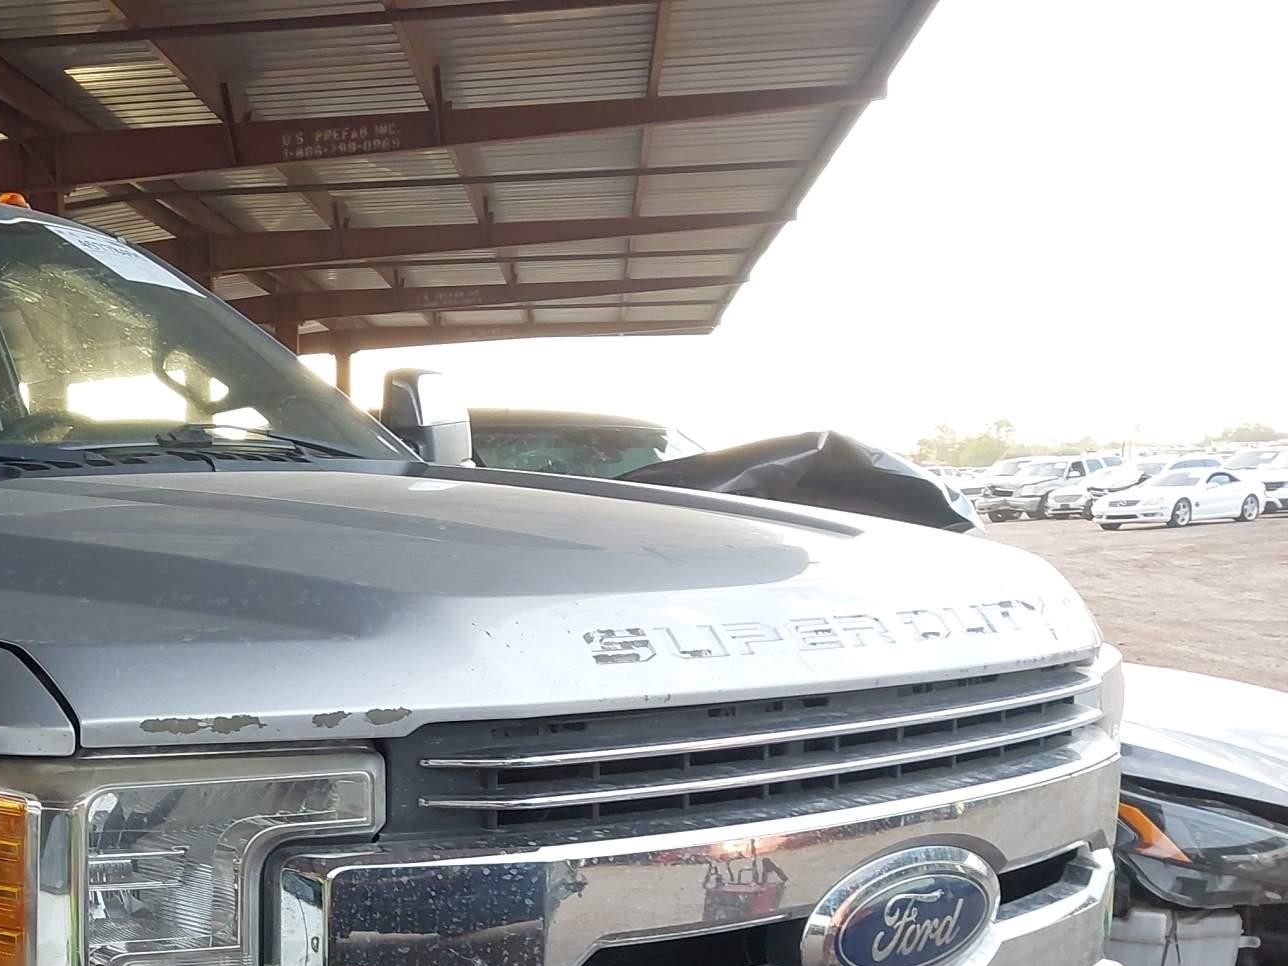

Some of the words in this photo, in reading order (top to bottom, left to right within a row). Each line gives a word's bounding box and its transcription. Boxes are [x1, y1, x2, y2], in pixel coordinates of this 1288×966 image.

[315, 127, 368, 142] PREFAB
[582, 613, 896, 665] SUPER
[872, 888, 964, 962] Ford
